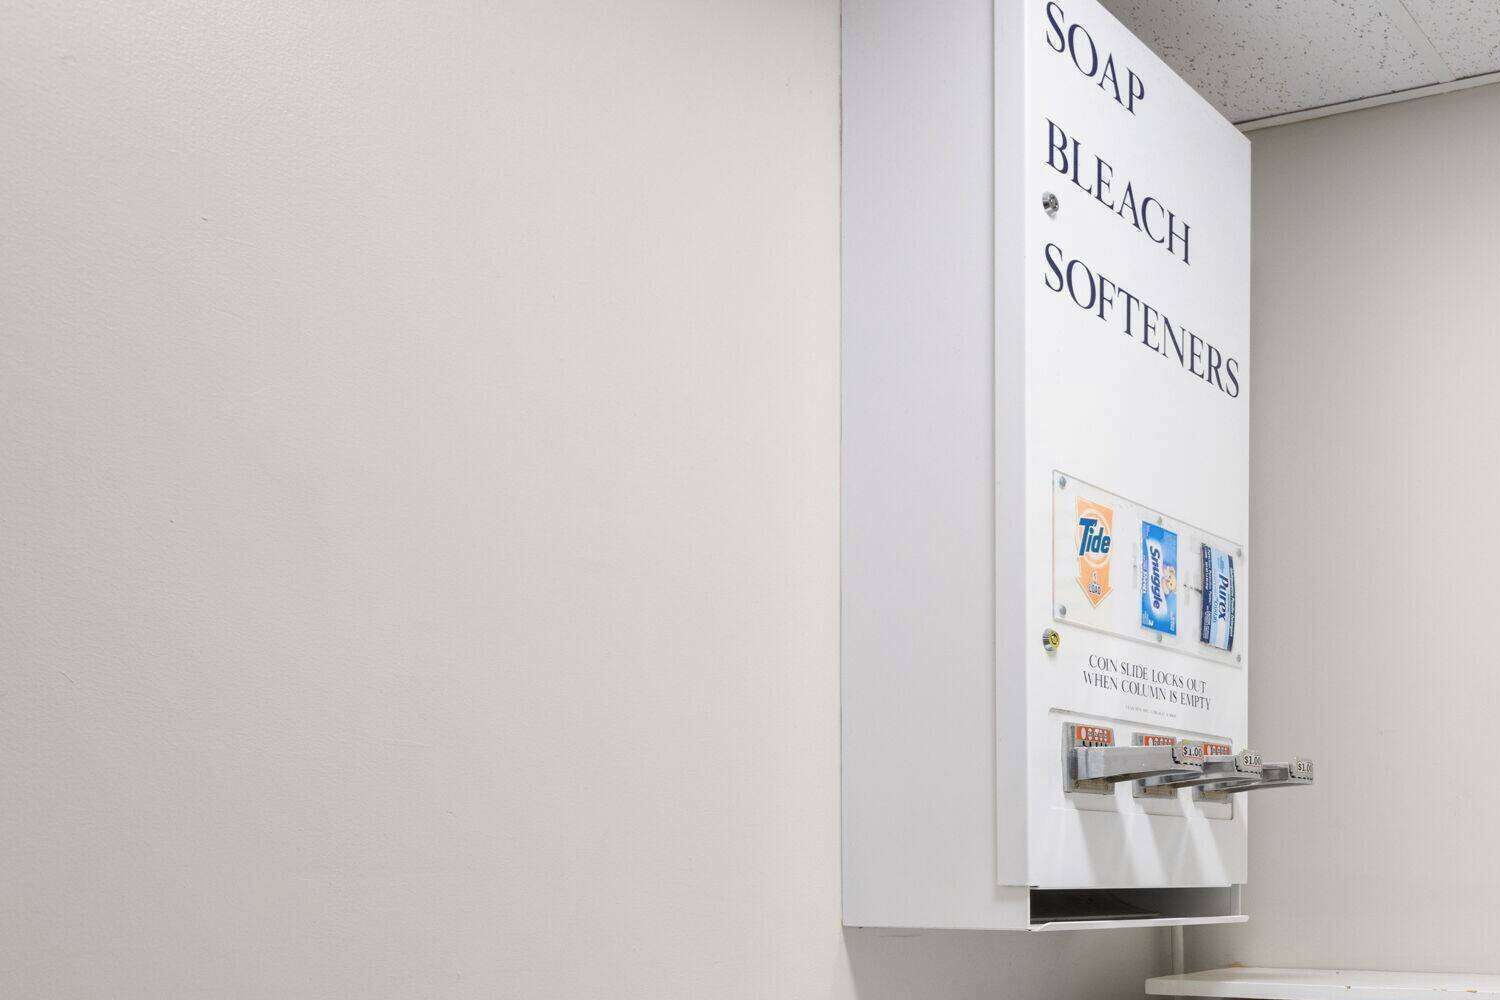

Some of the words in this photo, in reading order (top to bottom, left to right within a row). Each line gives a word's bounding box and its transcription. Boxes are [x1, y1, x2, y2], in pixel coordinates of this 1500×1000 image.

[1045, 1, 1145, 116] SOAP
[1045, 118, 1191, 265] BLEACH
[1044, 242, 1240, 399] SOFTENERS
[1079, 517, 1111, 556] Tide
[1149, 545, 1163, 610] Snuggle
[1217, 573, 1229, 621] Purex
[1082, 670, 1118, 691] WHEN
[1121, 679, 1166, 701] COLUMN
[1168, 689, 1178, 704] IS
[1180, 691, 1212, 711] EMPTY
[1088, 654, 1118, 672] COIN
[1120, 661, 1148, 681] SLIDE
[1151, 668, 1184, 689] LOCKS
[1186, 678, 1207, 694] OUT
